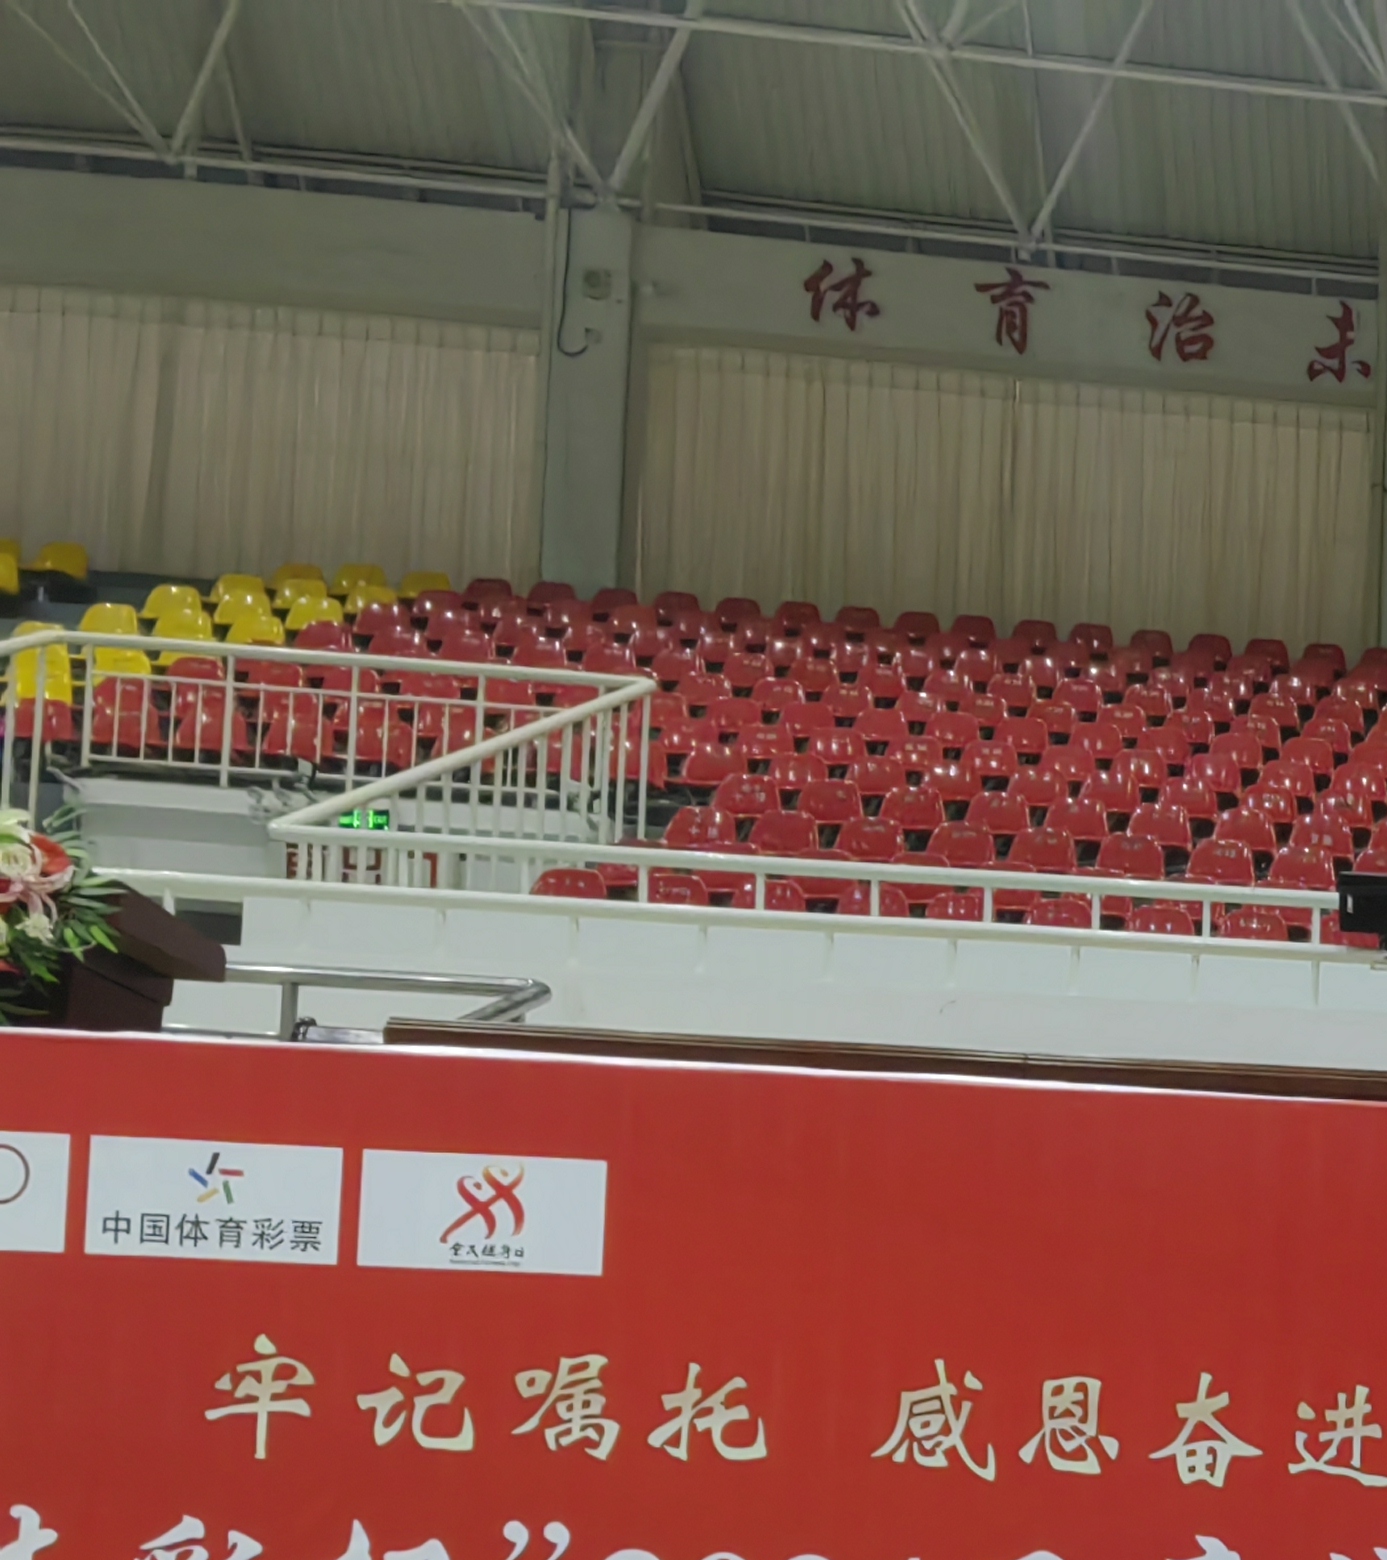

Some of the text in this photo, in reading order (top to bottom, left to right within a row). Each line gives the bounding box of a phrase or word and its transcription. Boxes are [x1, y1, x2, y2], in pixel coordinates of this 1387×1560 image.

[102, 1211, 323, 1252] 中国体育彩票
[204, 1333, 768, 1462] 牢记嘱托
